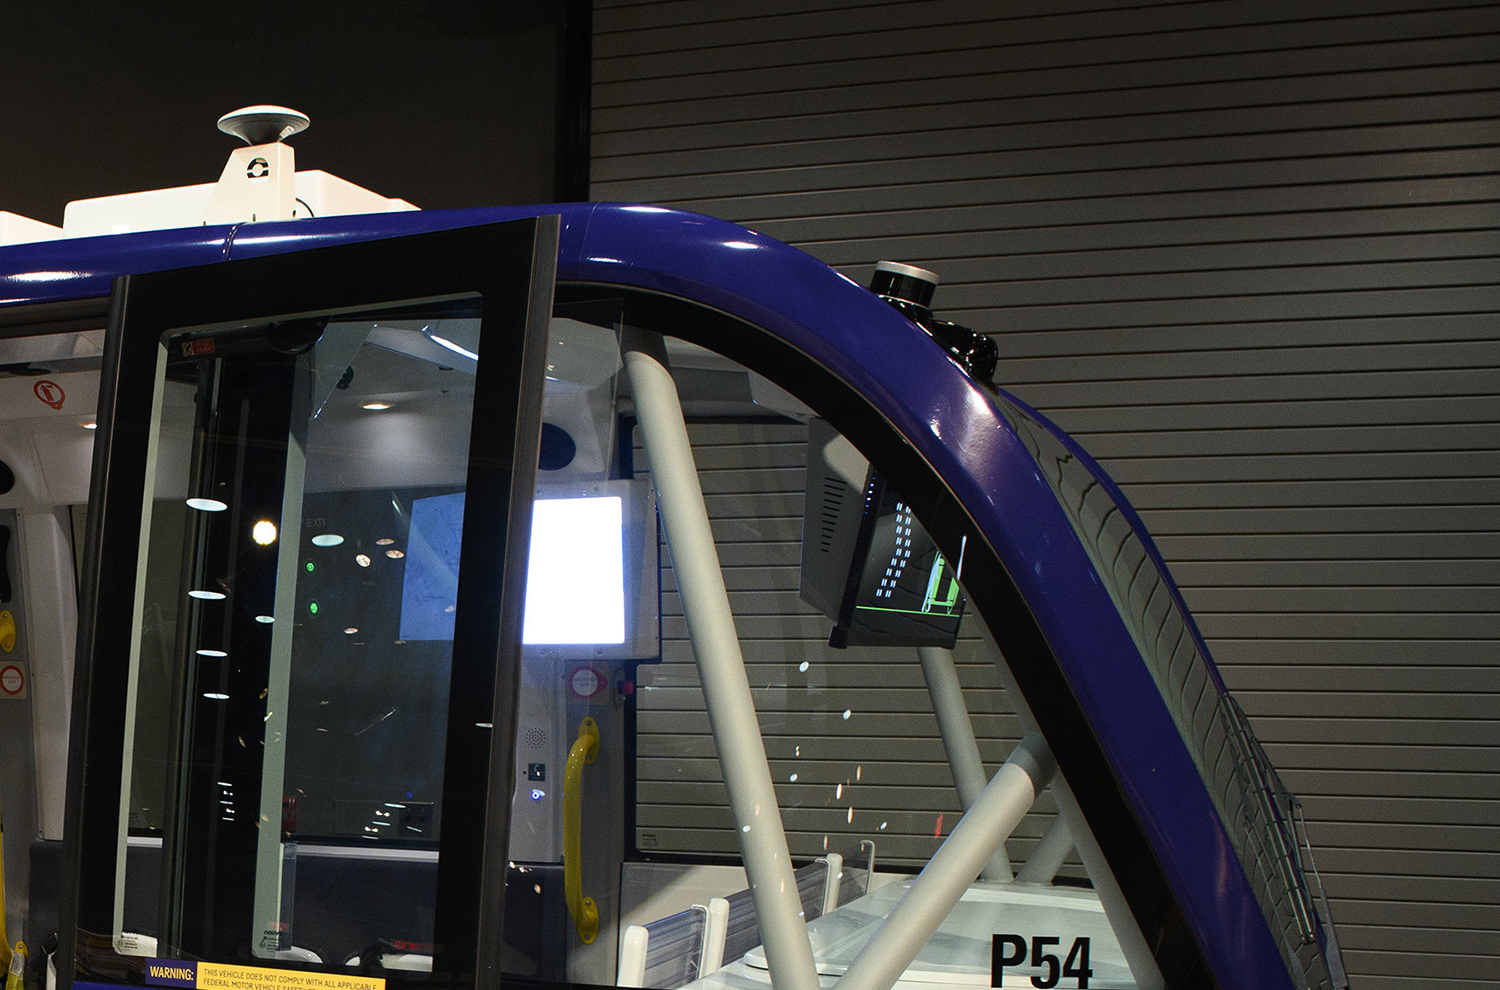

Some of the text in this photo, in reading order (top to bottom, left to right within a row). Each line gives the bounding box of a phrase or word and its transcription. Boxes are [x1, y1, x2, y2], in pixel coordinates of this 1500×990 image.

[991, 934, 1093, 990] P54
[149, 966, 194, 981] WARNING:
[204, 968, 218, 976] THIS
[219, 969, 244, 979] VEHICLE
[246, 972, 263, 981] DOES
[264, 974, 277, 982] NOT
[278, 975, 305, 985] COMPLY
[305, 978, 323, 987] WITH
[324, 980, 336, 988] ALL
[203, 978, 230, 988] FEDERAL
[231, 981, 254, 990] MOTOR
